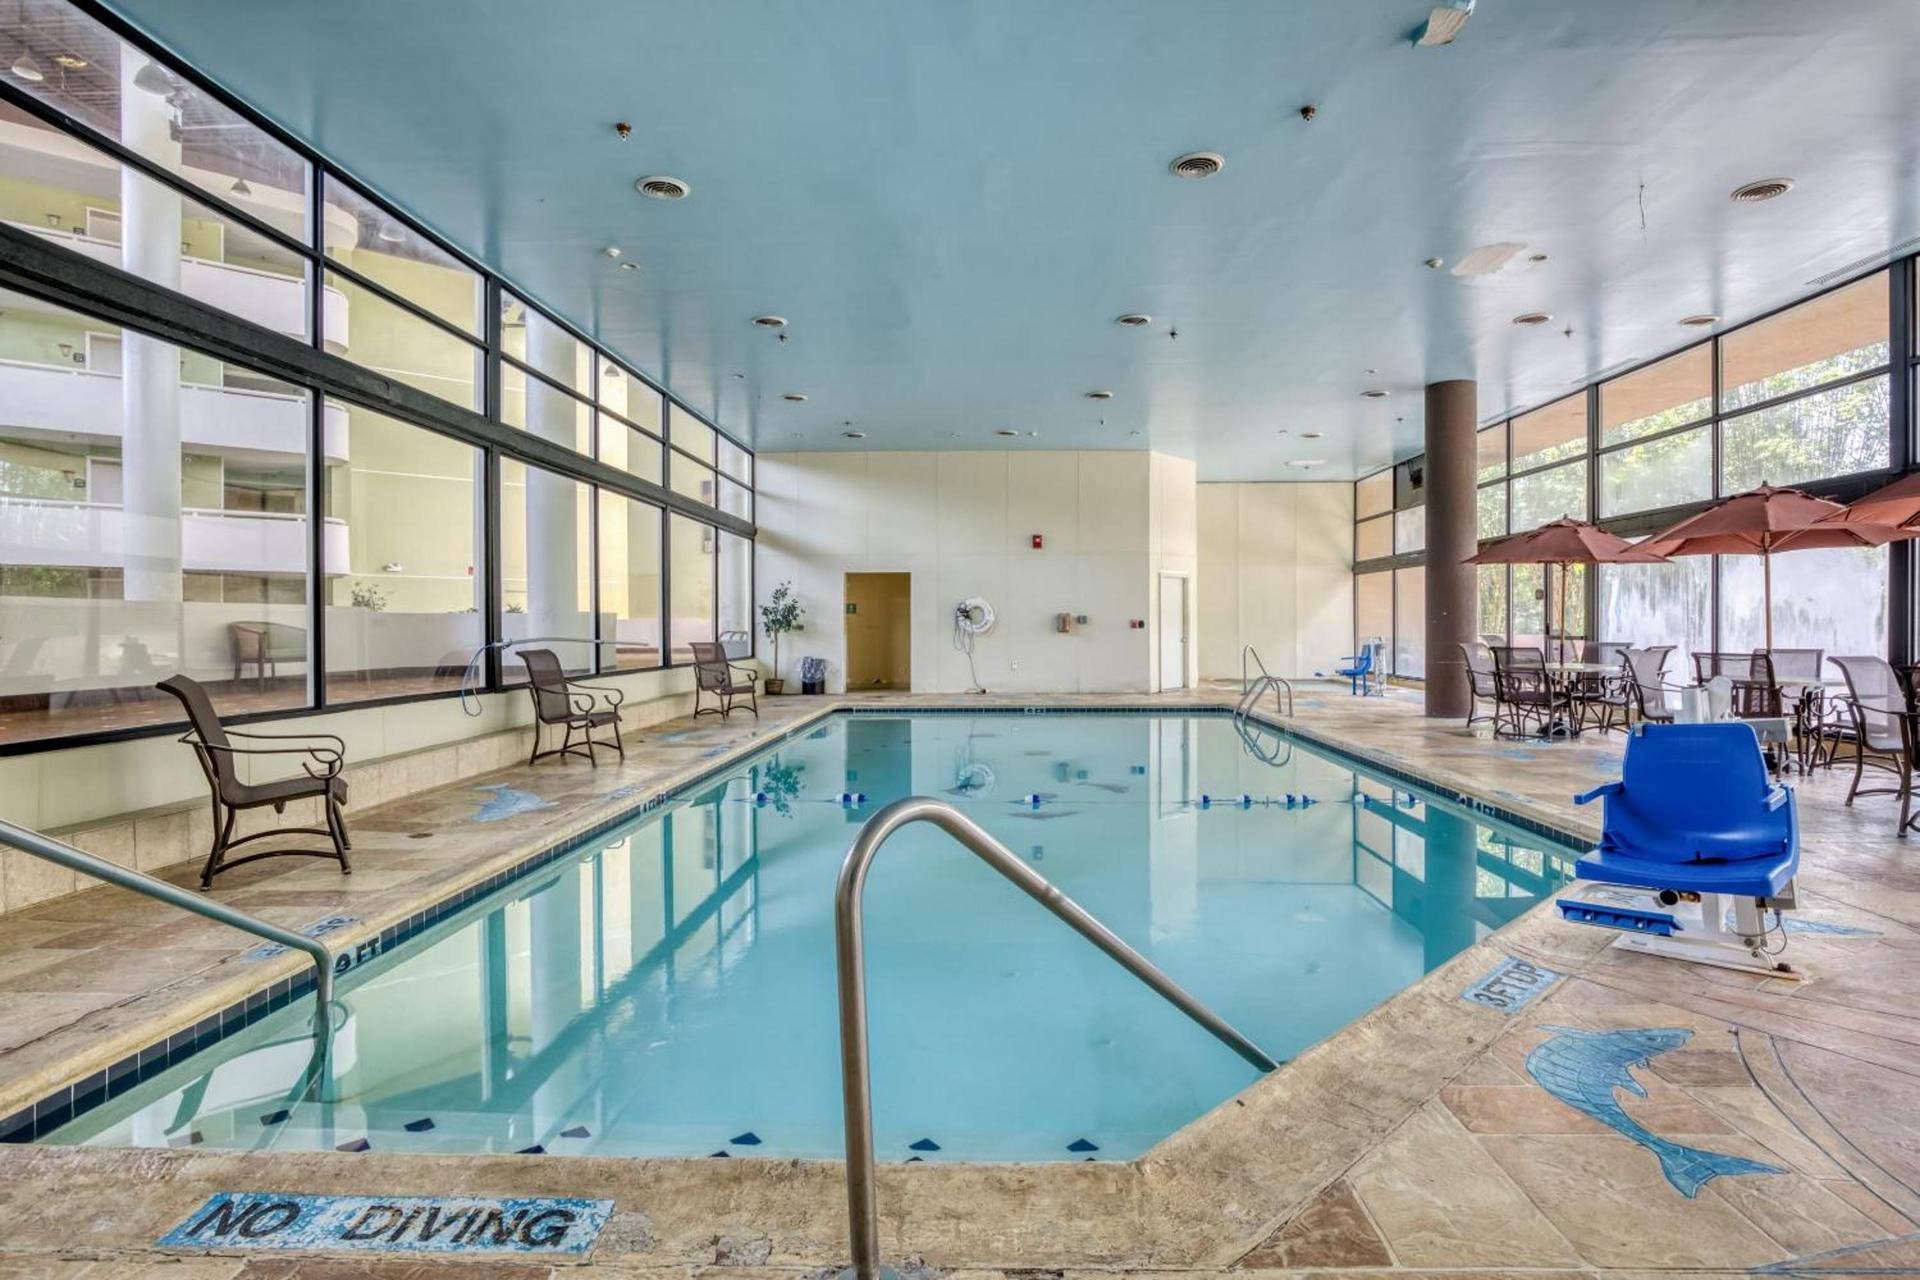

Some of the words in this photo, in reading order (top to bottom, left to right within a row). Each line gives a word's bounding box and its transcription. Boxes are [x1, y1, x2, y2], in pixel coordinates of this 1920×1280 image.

[355, 936, 380, 963] FT
[185, 1199, 301, 1238] NO
[339, 1204, 577, 1247] DIVING
